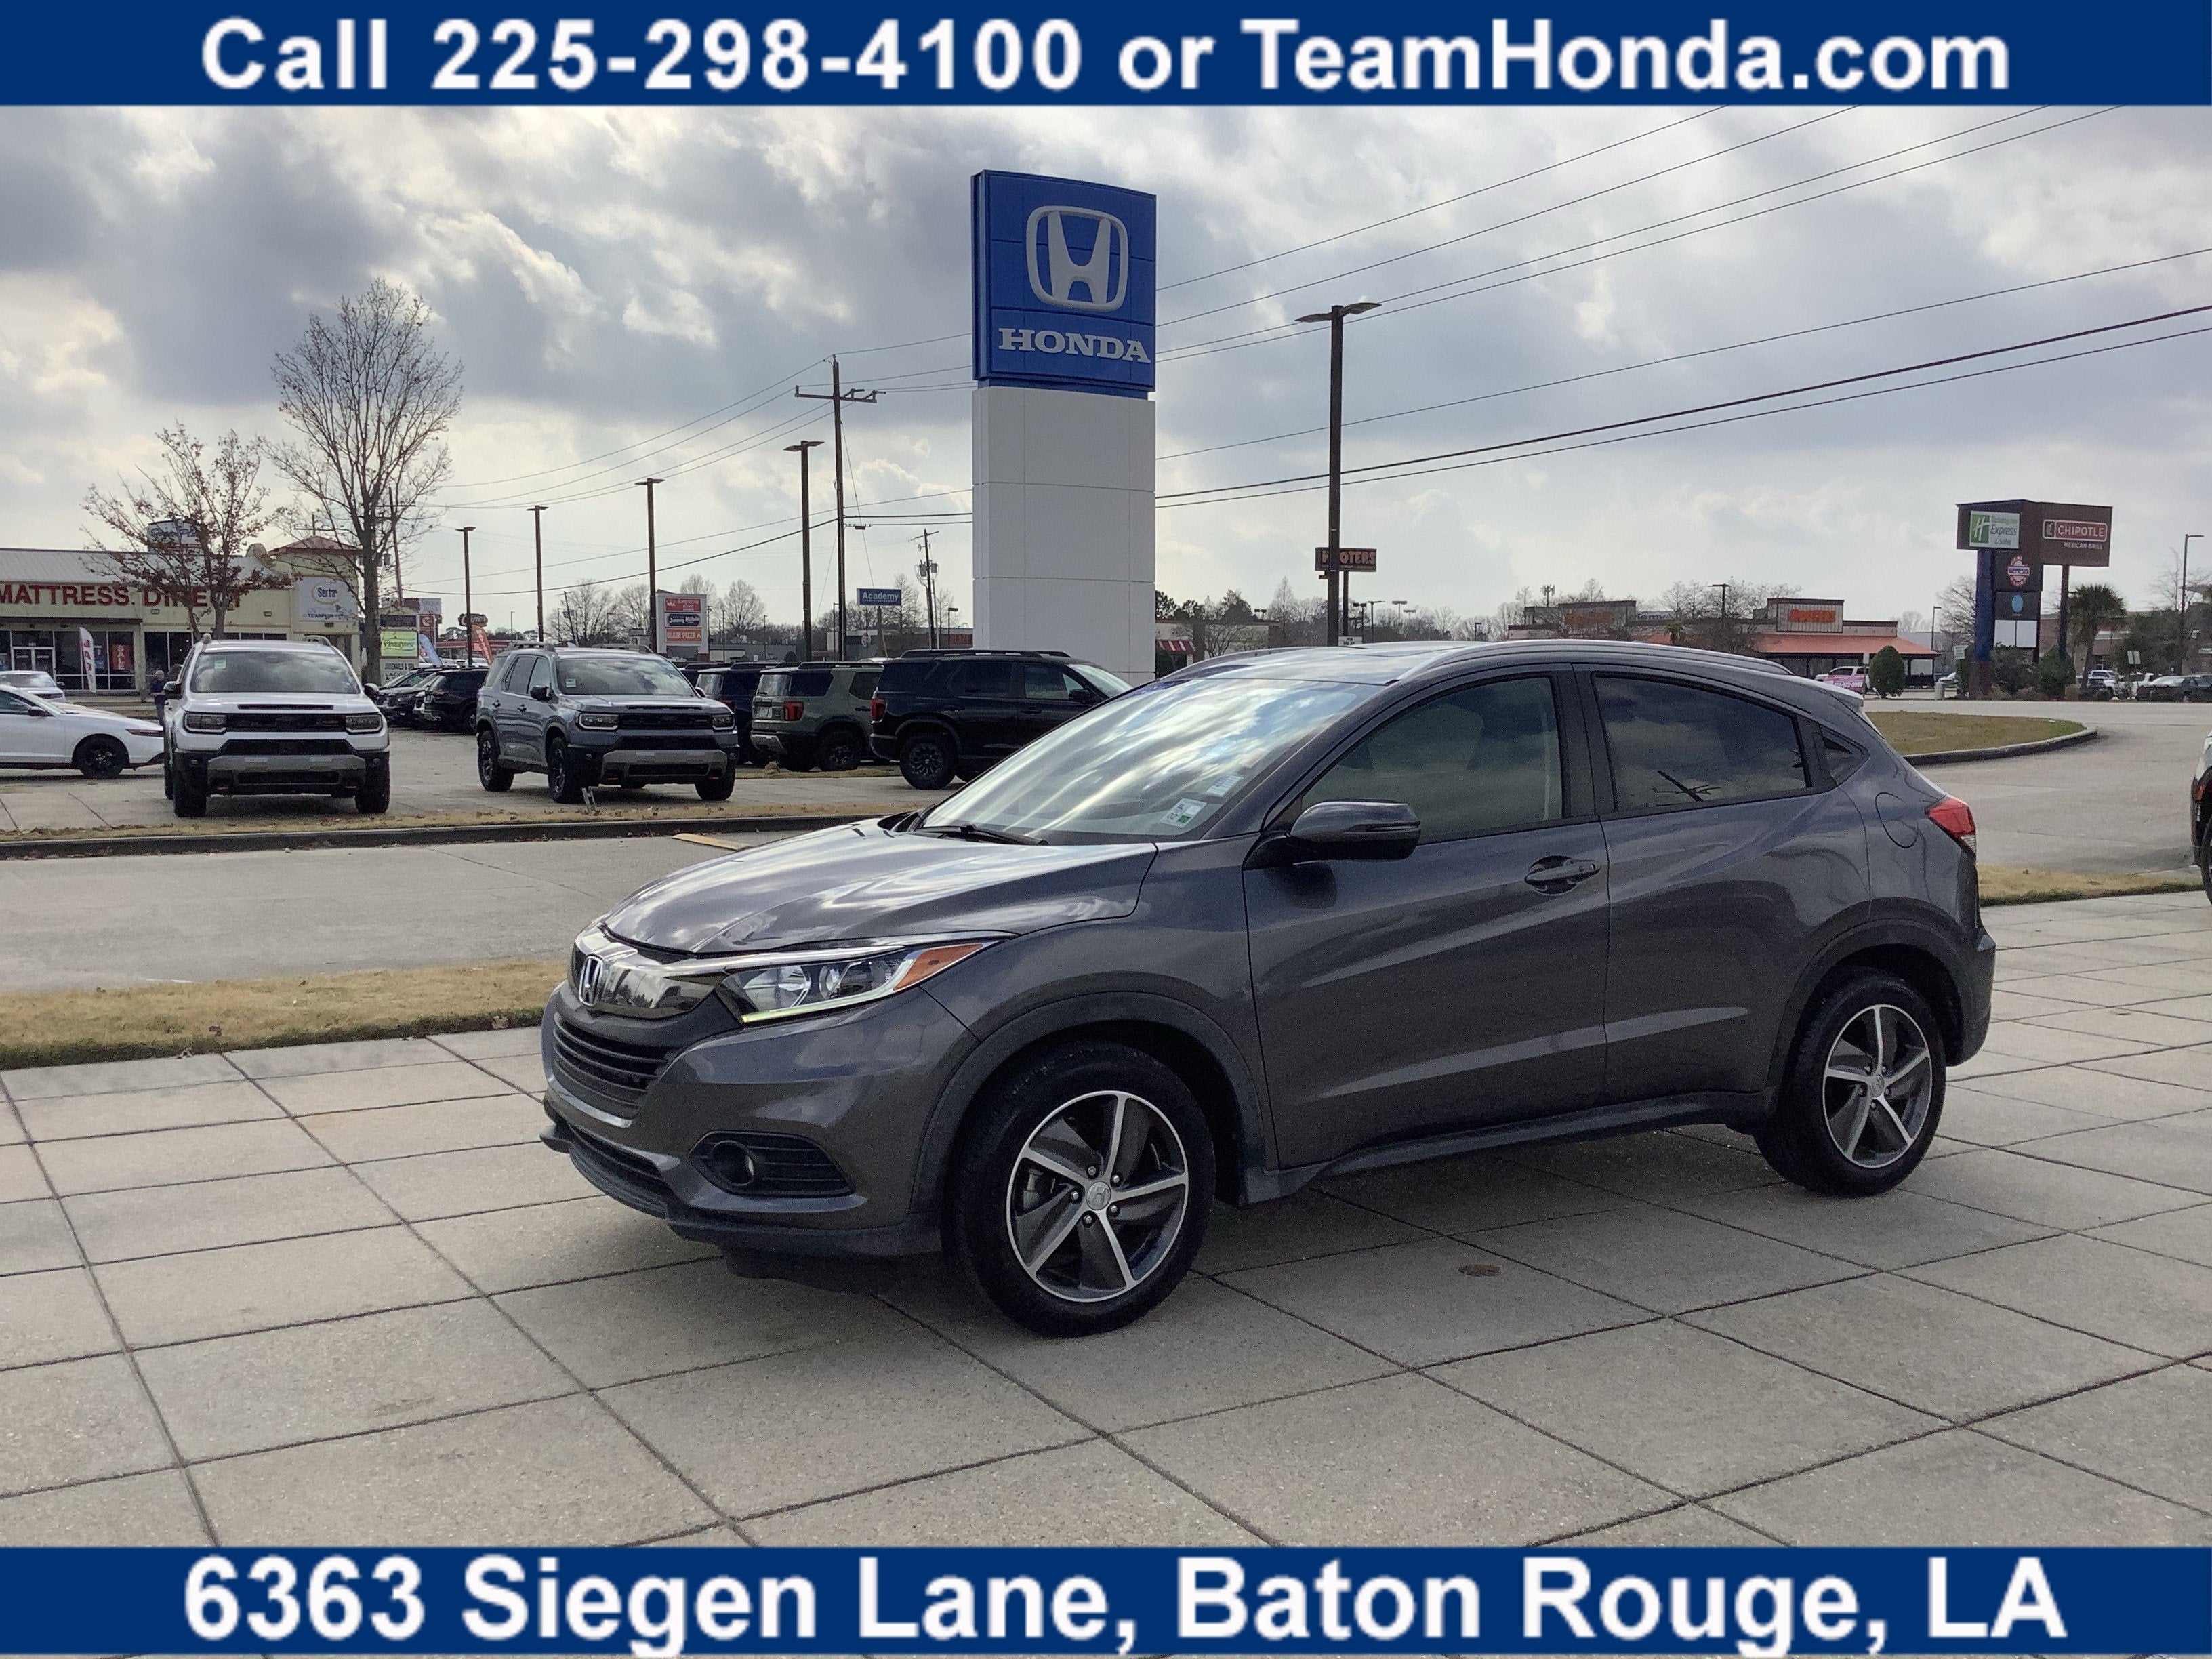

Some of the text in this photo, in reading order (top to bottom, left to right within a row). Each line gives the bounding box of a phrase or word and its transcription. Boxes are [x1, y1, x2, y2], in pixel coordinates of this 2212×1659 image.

[998, 327, 1151, 364] HONDA
[2057, 527, 2104, 537] CHIPOTLE
[1322, 550, 1375, 564] HOTERS
[0, 583, 129, 606] MATTRESS
[862, 592, 899, 602] Academy
